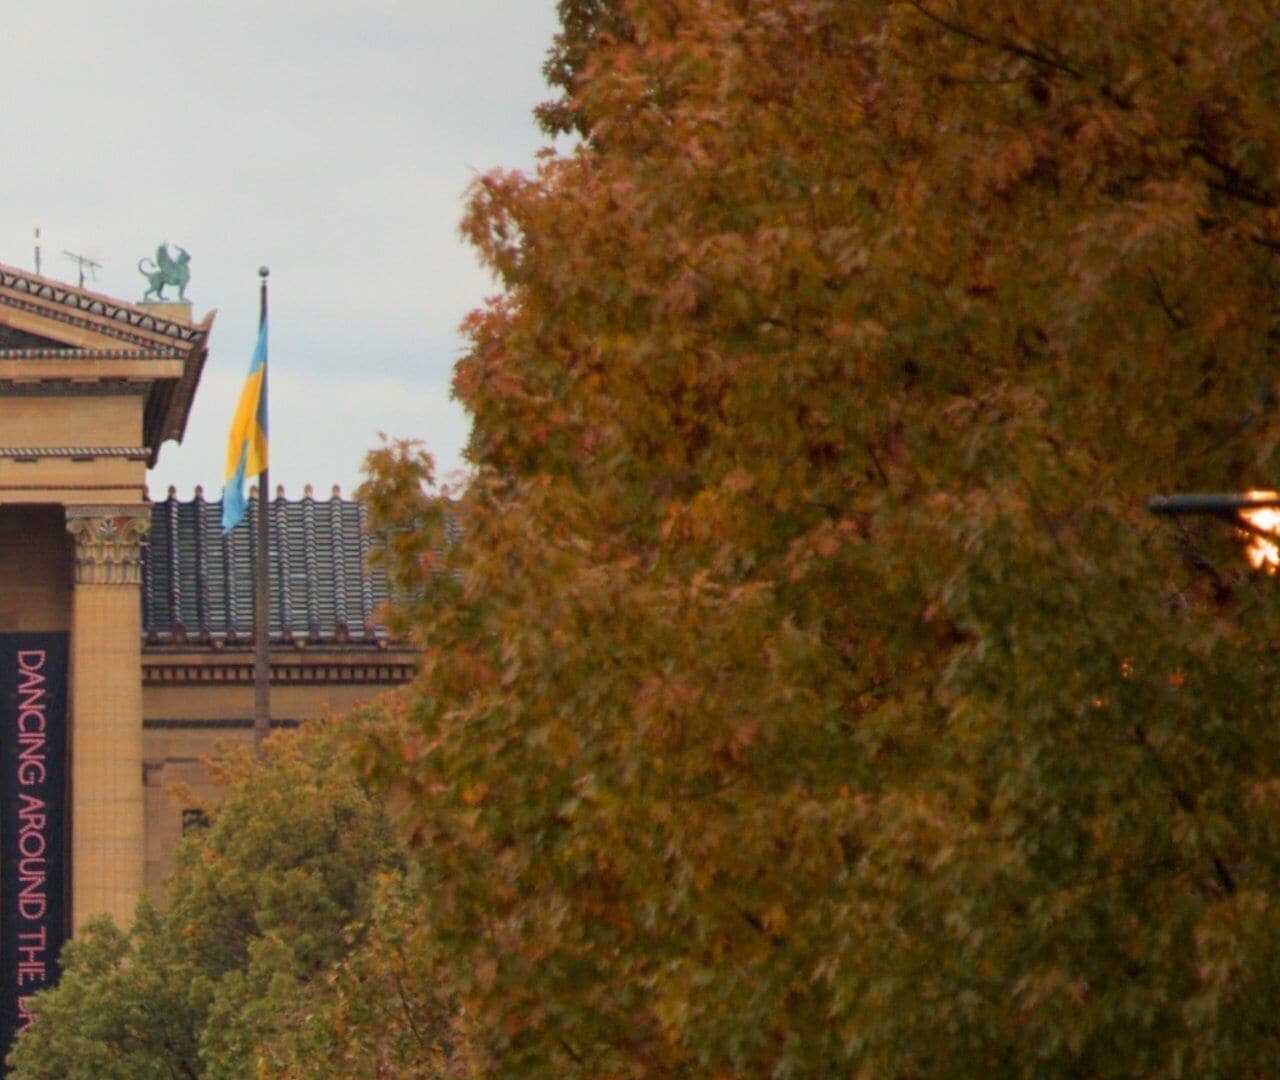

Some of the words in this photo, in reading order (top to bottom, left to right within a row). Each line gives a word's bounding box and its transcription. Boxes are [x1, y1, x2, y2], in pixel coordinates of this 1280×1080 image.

[17, 649, 46, 784] DANCING
[17, 794, 46, 920] AROUND
[17, 926, 46, 986] THE
